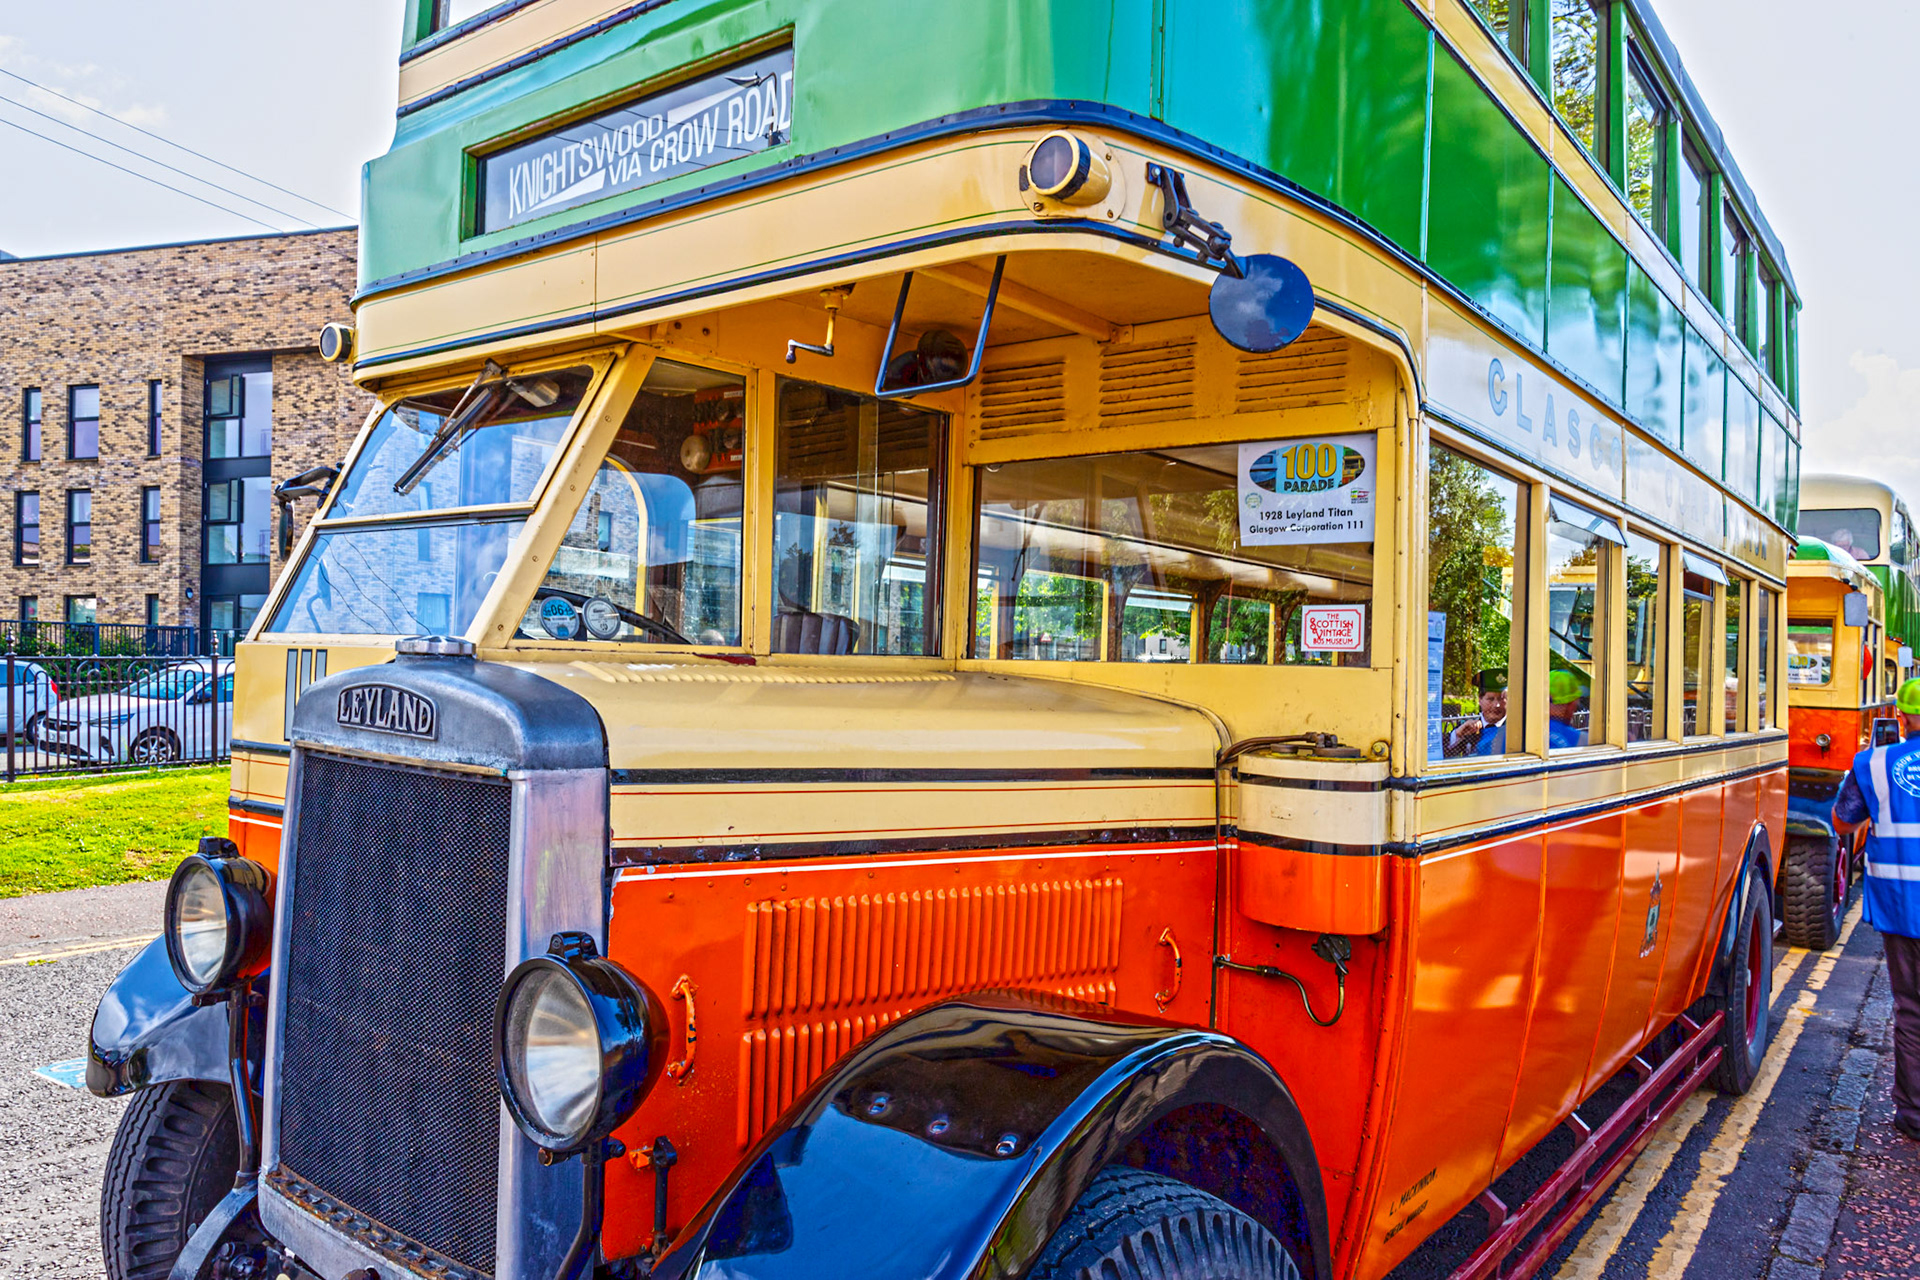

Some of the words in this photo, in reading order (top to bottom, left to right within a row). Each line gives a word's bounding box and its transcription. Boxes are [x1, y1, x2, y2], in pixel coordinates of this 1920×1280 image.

[608, 158, 642, 186] VIA
[649, 107, 720, 173] CROW
[509, 114, 664, 219] KNIGHTSWOOD
[1282, 443, 1337, 479] 100
[1283, 479, 1335, 493] PARADE
[1260, 511, 1283, 521] 1928
[1286, 509, 1325, 522] Leyland
[1328, 508, 1354, 518] Titan
[1249, 525, 1288, 536] Glasgow
[1290, 522, 1344, 534] Corporation
[1347, 520, 1364, 530] 111
[1310, 617, 1354, 630] SCOTTISH
[1312, 628, 1352, 639] VINTAGE
[339, 688, 431, 733] LEYLAND
